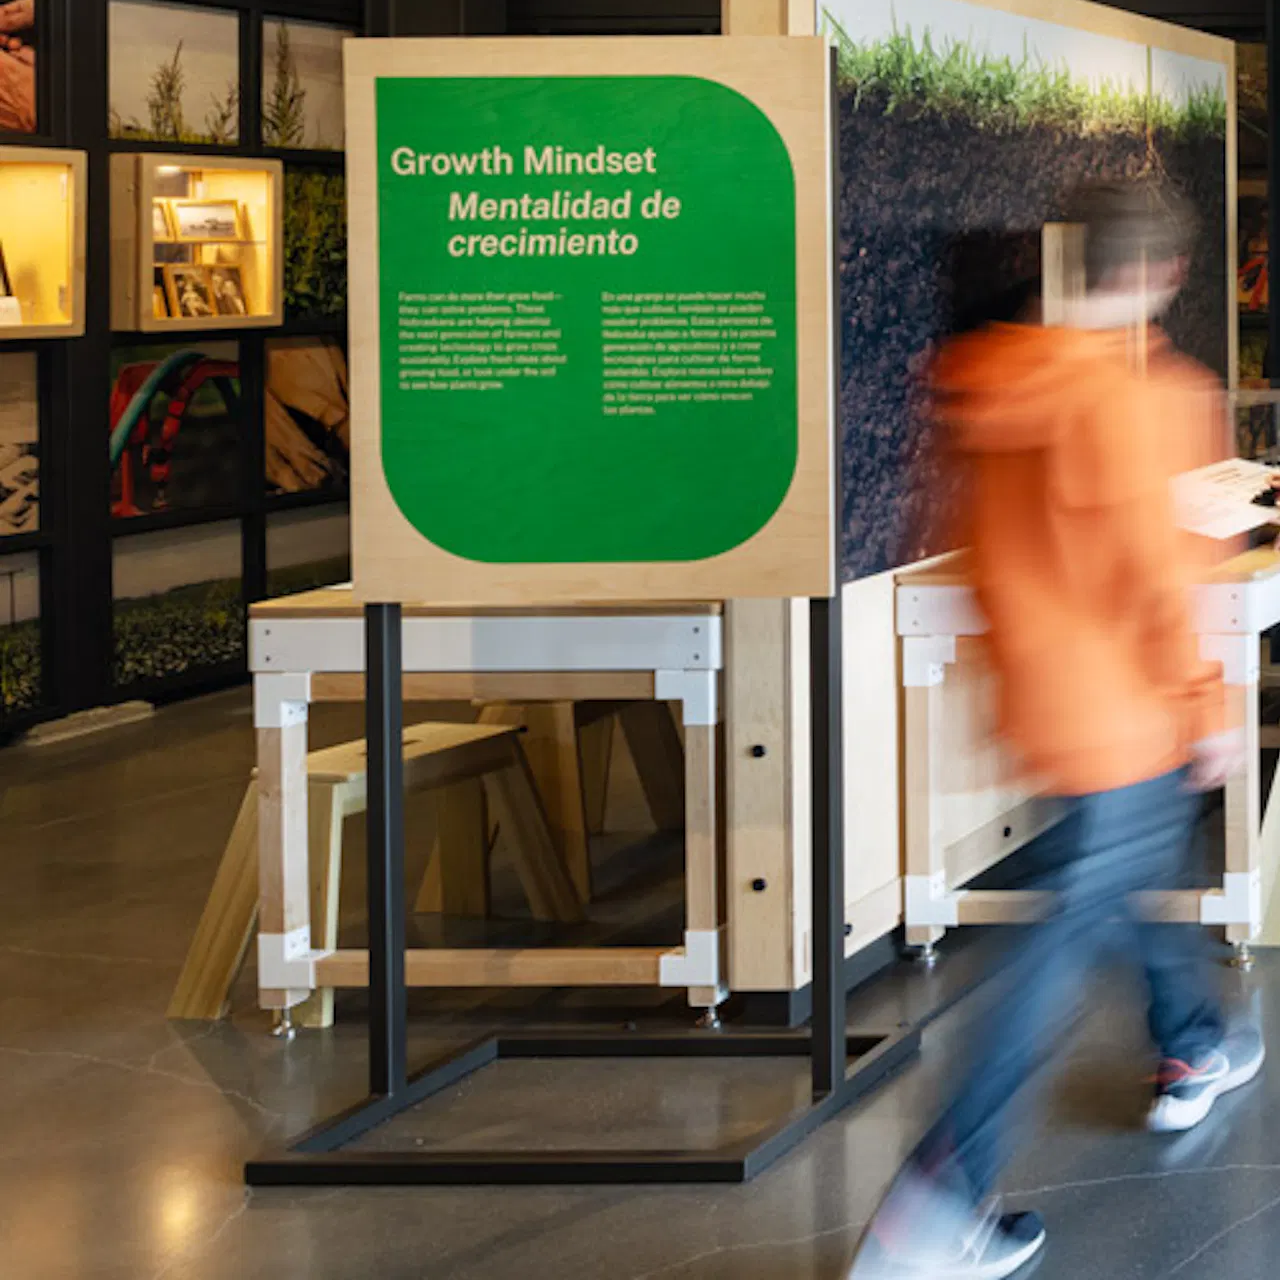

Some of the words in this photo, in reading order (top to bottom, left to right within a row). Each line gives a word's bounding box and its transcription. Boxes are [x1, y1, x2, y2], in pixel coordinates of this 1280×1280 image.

[391, 146, 513, 175] Growth
[523, 145, 656, 174] Mindset
[448, 190, 631, 220] Mentalidad
[640, 190, 681, 219] de
[448, 227, 639, 257] crecimiento
